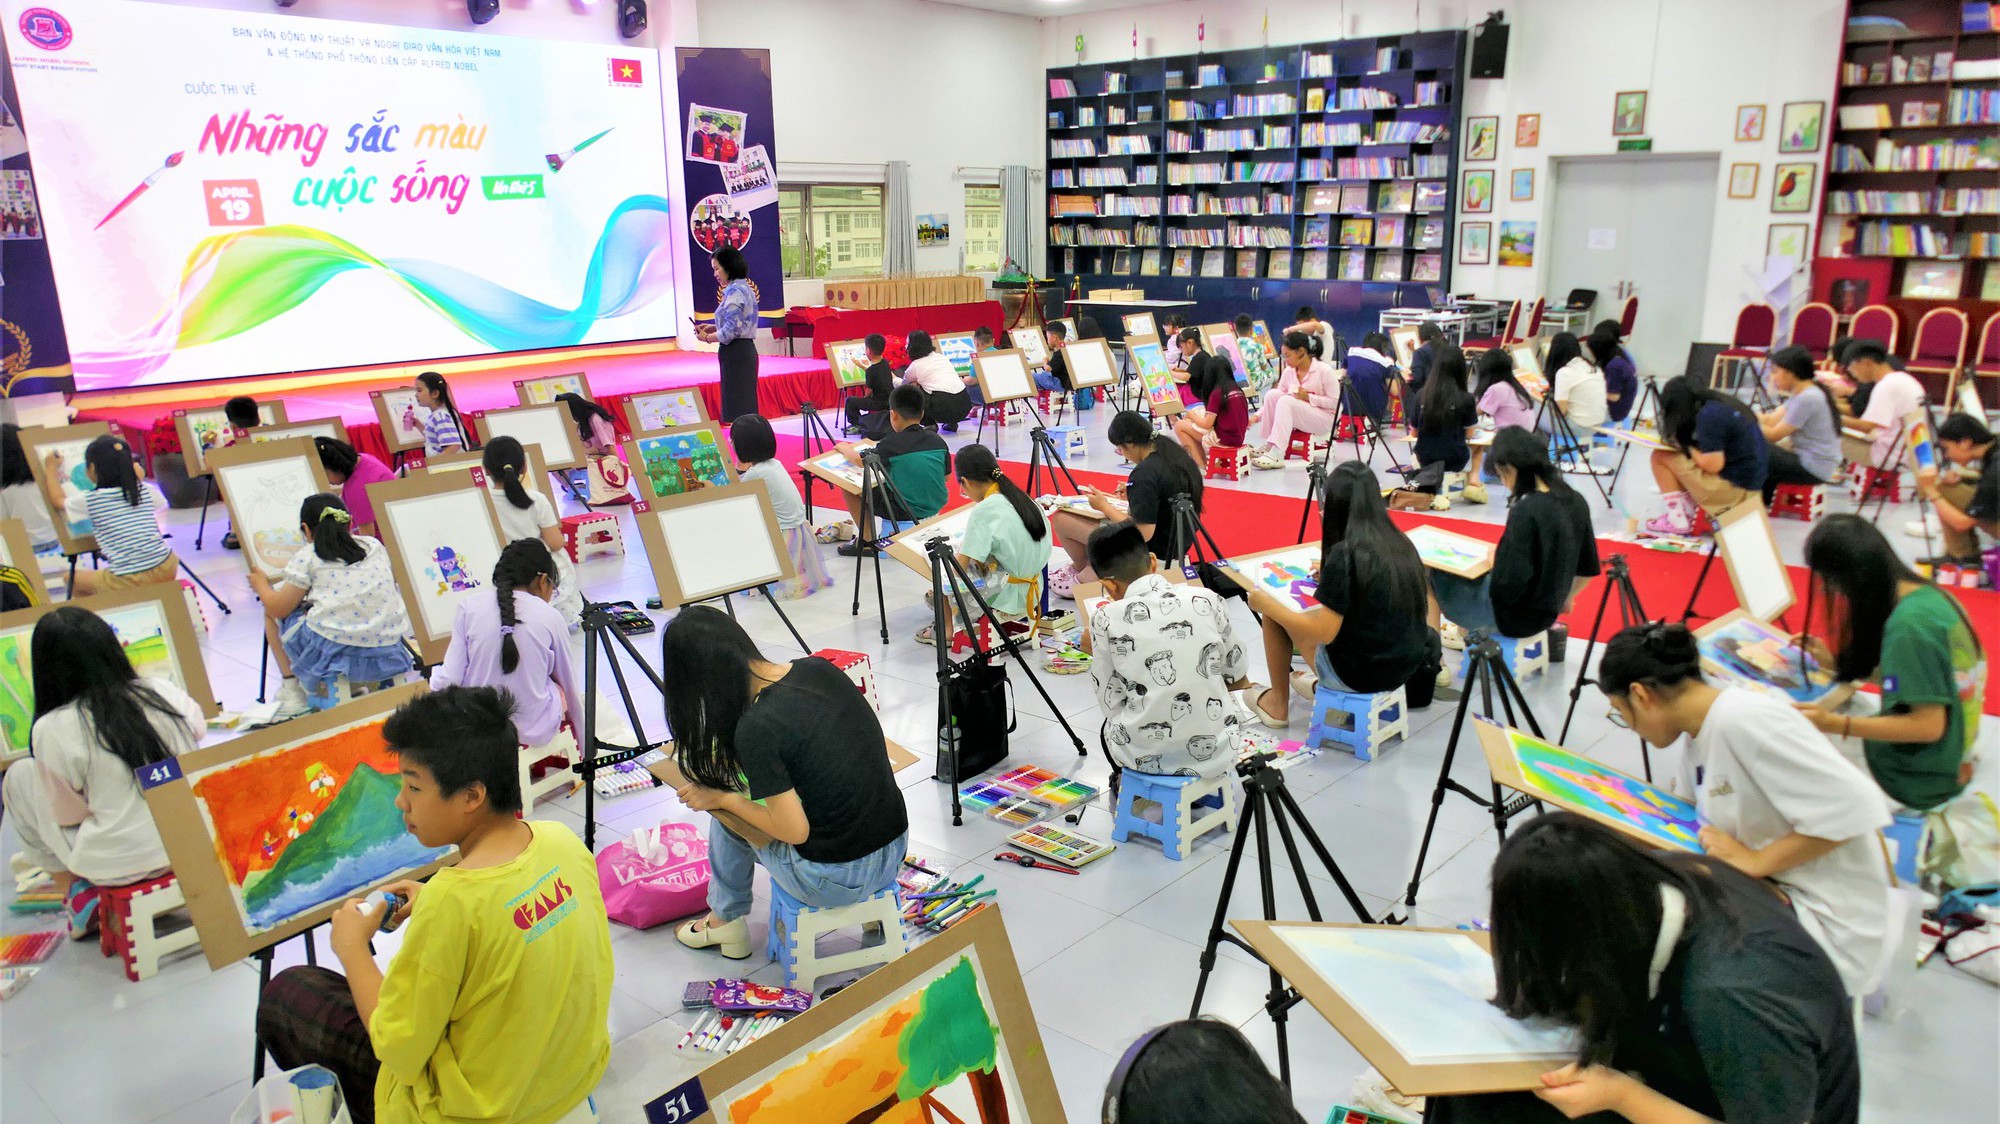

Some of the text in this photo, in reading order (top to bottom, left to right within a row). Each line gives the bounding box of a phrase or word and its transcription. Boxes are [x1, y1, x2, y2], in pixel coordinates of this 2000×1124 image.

[232, 27, 252, 37] BAN
[403, 41, 423, 51] GIAO
[464, 45, 481, 57] VIỆT
[484, 48, 502, 57] NAM
[421, 59, 451, 69] ALFRED
[454, 61, 480, 72] NOBEL
[184, 81, 217, 96] CUỘC
[220, 84, 239, 95] THI
[198, 108, 488, 167] Những sắc màu
[212, 186, 254, 199] APRIL
[292, 160, 471, 215] cuộc sống
[220, 199, 251, 222] 19
[149, 764, 173, 783] 41
[664, 1092, 693, 1123] 51
